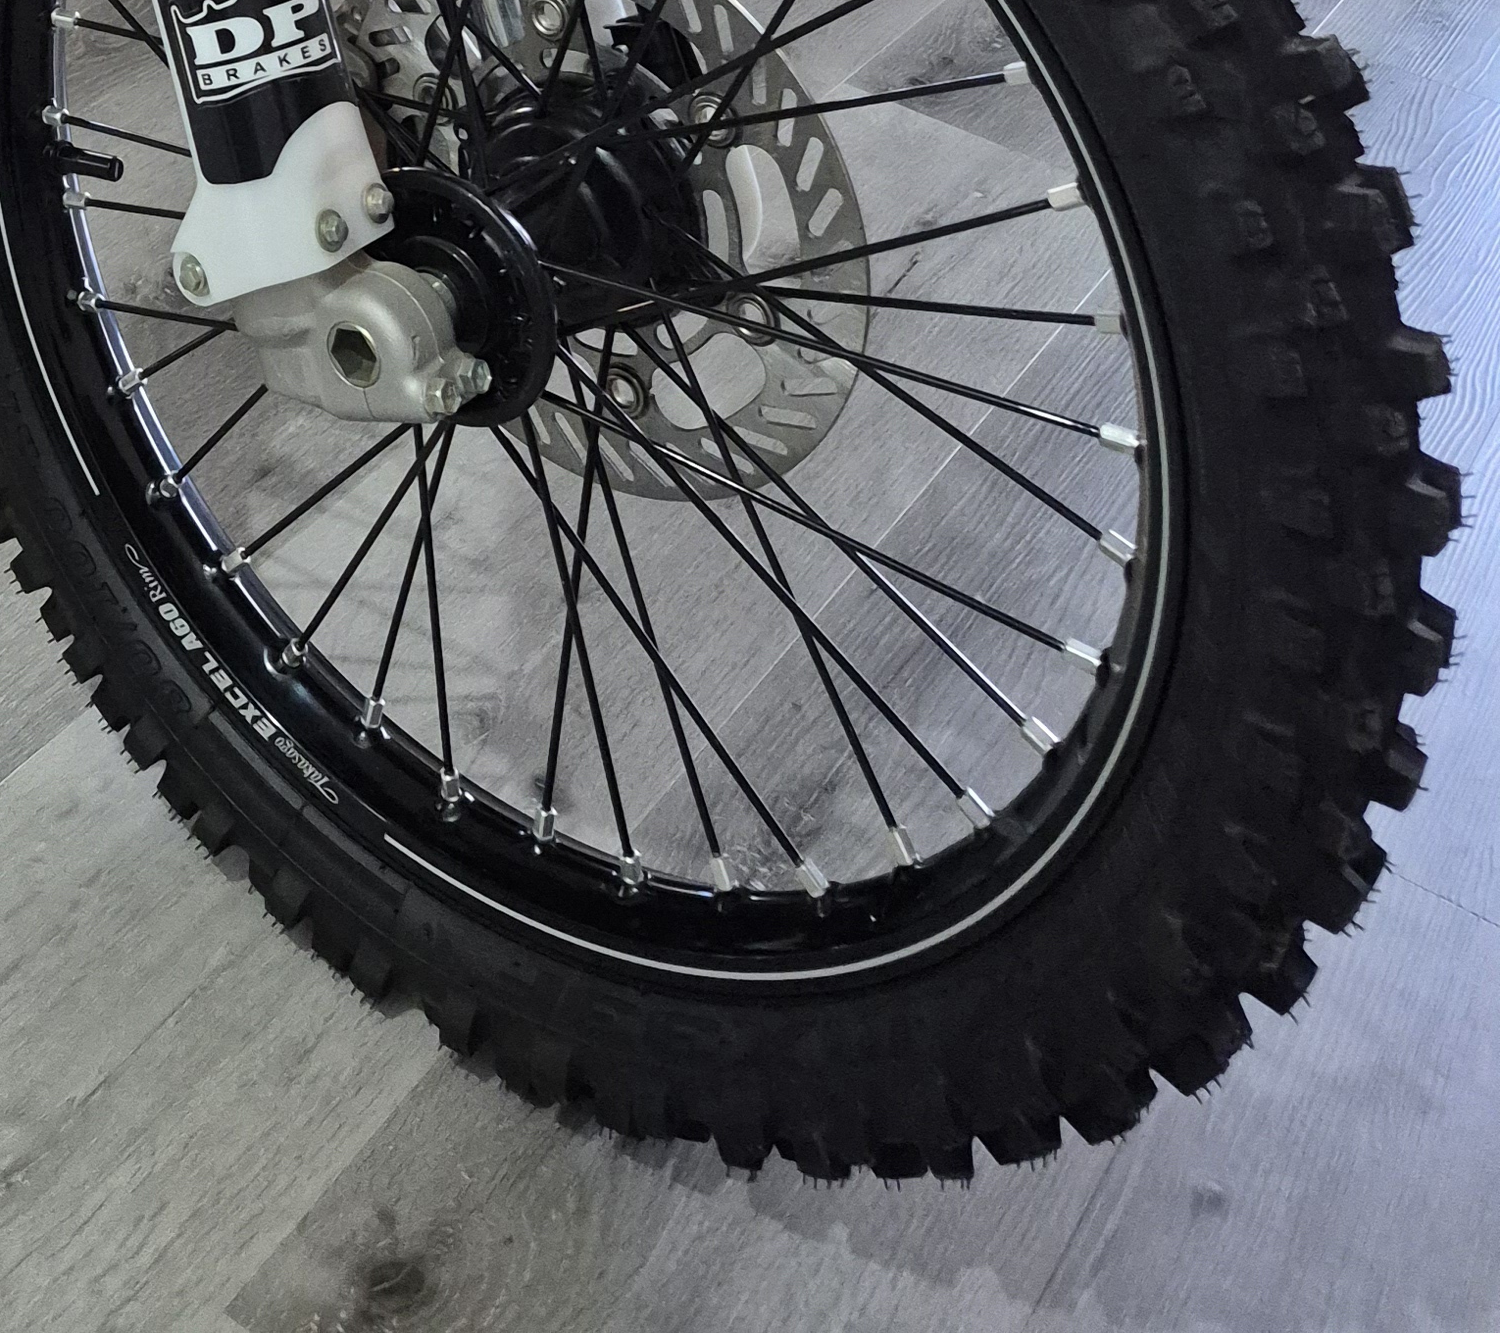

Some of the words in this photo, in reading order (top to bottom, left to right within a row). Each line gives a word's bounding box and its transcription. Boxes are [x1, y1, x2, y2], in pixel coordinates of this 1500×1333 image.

[201, 36, 330, 87] BRAKES
[158, 602, 204, 652] A60
[200, 650, 277, 742] EXCEL
[273, 735, 340, 806] Takasago
